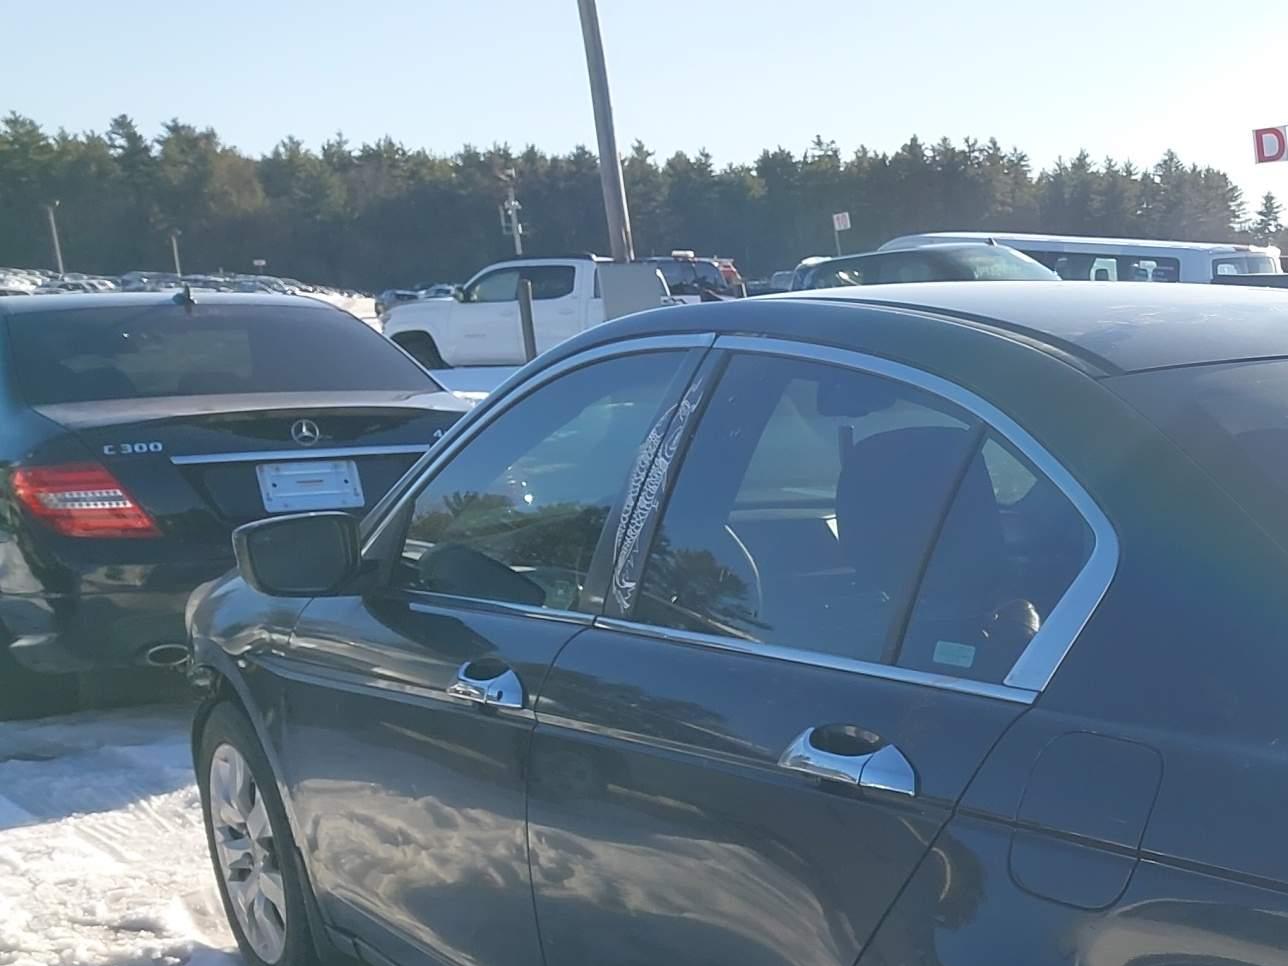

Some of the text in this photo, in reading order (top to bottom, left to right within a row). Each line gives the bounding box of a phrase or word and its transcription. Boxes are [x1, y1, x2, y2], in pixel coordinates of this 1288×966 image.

[1255, 127, 1285, 163] D
[103, 441, 162, 456] C 300
